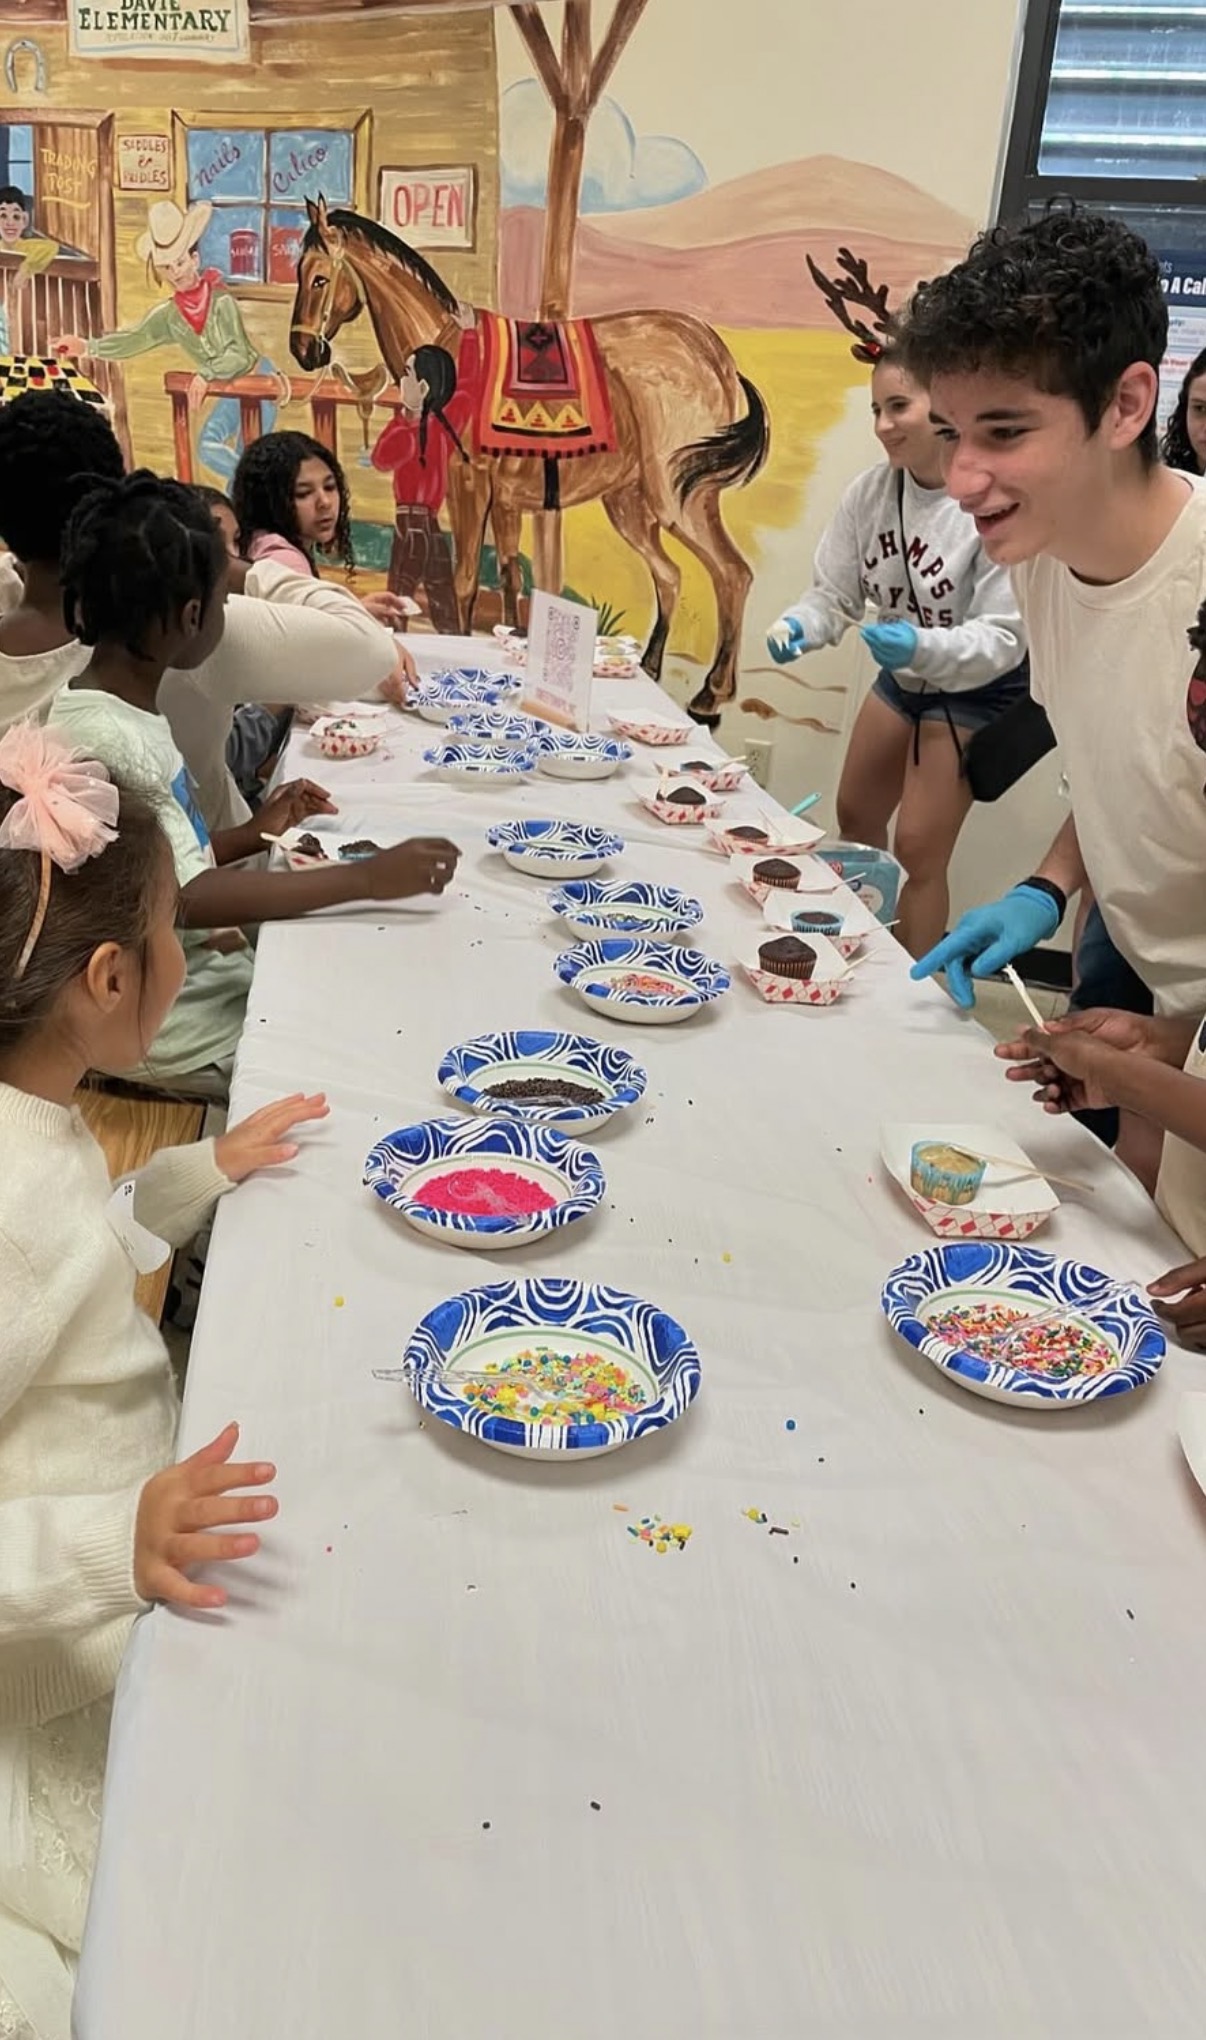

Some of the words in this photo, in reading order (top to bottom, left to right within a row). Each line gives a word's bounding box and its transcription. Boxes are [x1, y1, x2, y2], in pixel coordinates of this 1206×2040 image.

[78, 8, 231, 33] ELEMENTARY
[40, 148, 98, 179] TRADING
[48, 172, 82, 194] POST
[393, 183, 464, 227] OPEN
[1170, 276, 1181, 294] A
[864, 529, 955, 600] CHMPS
